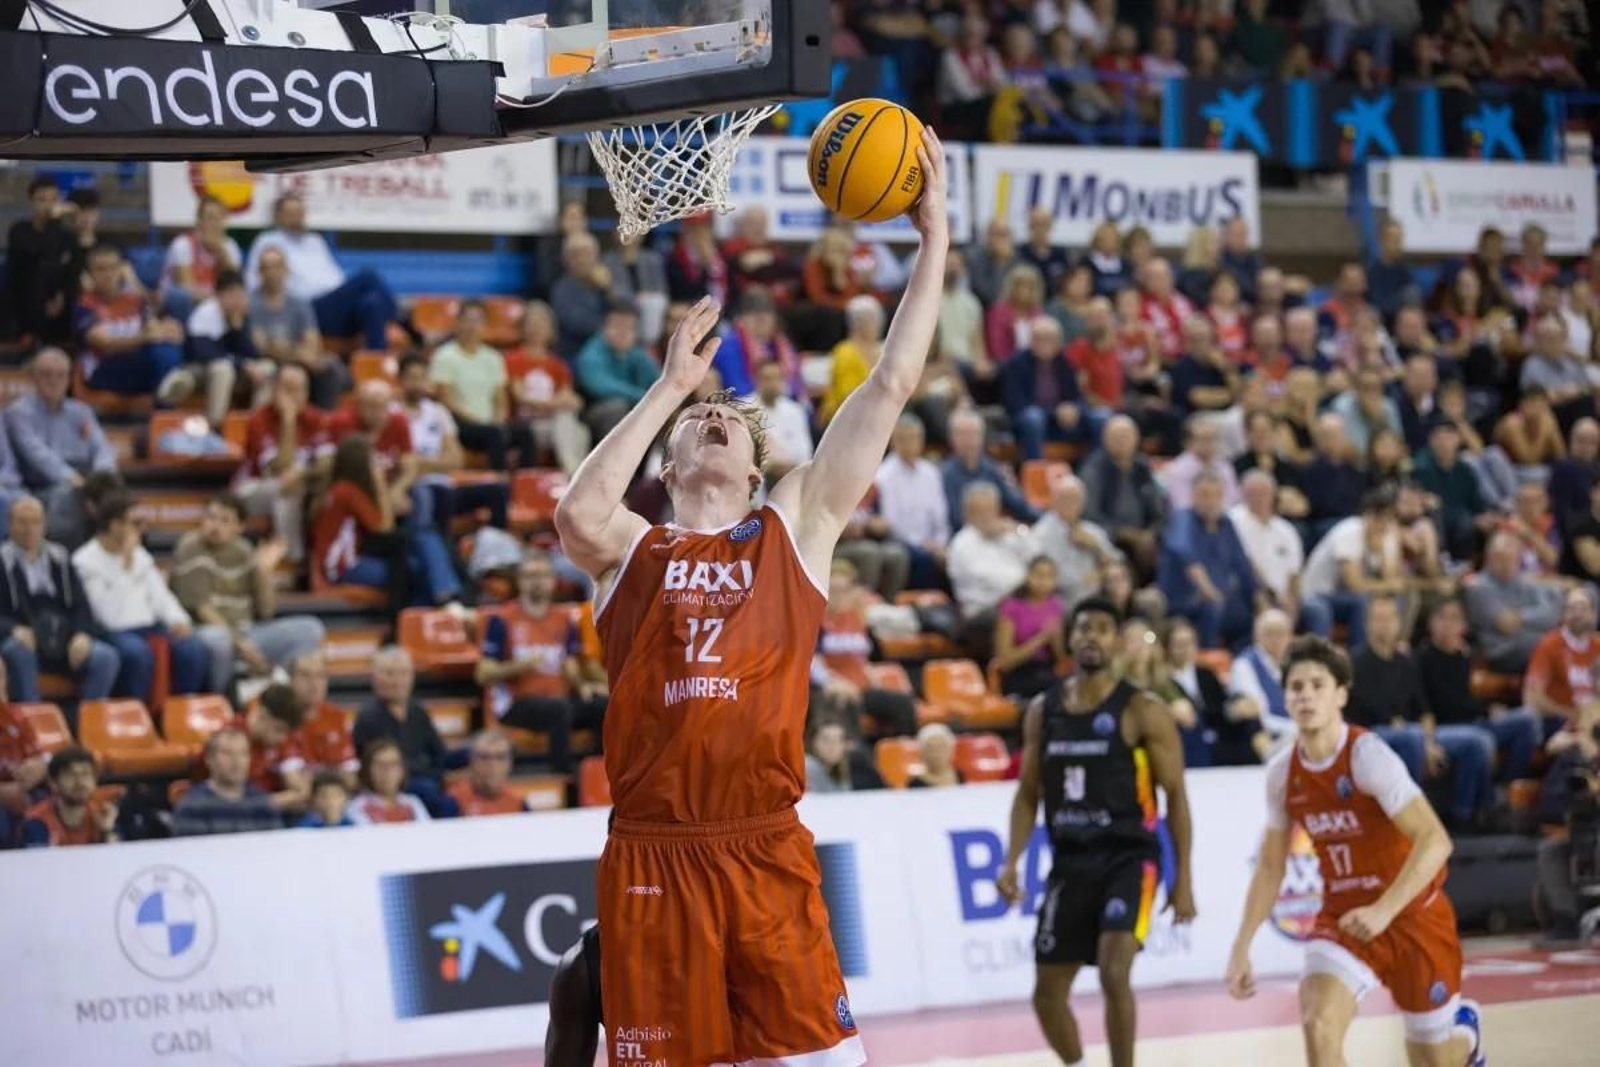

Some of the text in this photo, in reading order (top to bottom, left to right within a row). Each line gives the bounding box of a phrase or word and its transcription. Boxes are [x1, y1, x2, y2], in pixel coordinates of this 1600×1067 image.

[46, 51, 378, 128] endesa
[817, 112, 864, 187] Wilson
[901, 165, 919, 193] FIBA
[664, 559, 753, 593] BAXI
[685, 617, 725, 663] 12
[664, 677, 740, 706] MANRESA
[1327, 843, 1353, 877] 17
[76, 984, 276, 1023] MOTOR MUNICH
[616, 1026, 672, 1041] Adbisio
[617, 1042, 646, 1059] ETL
